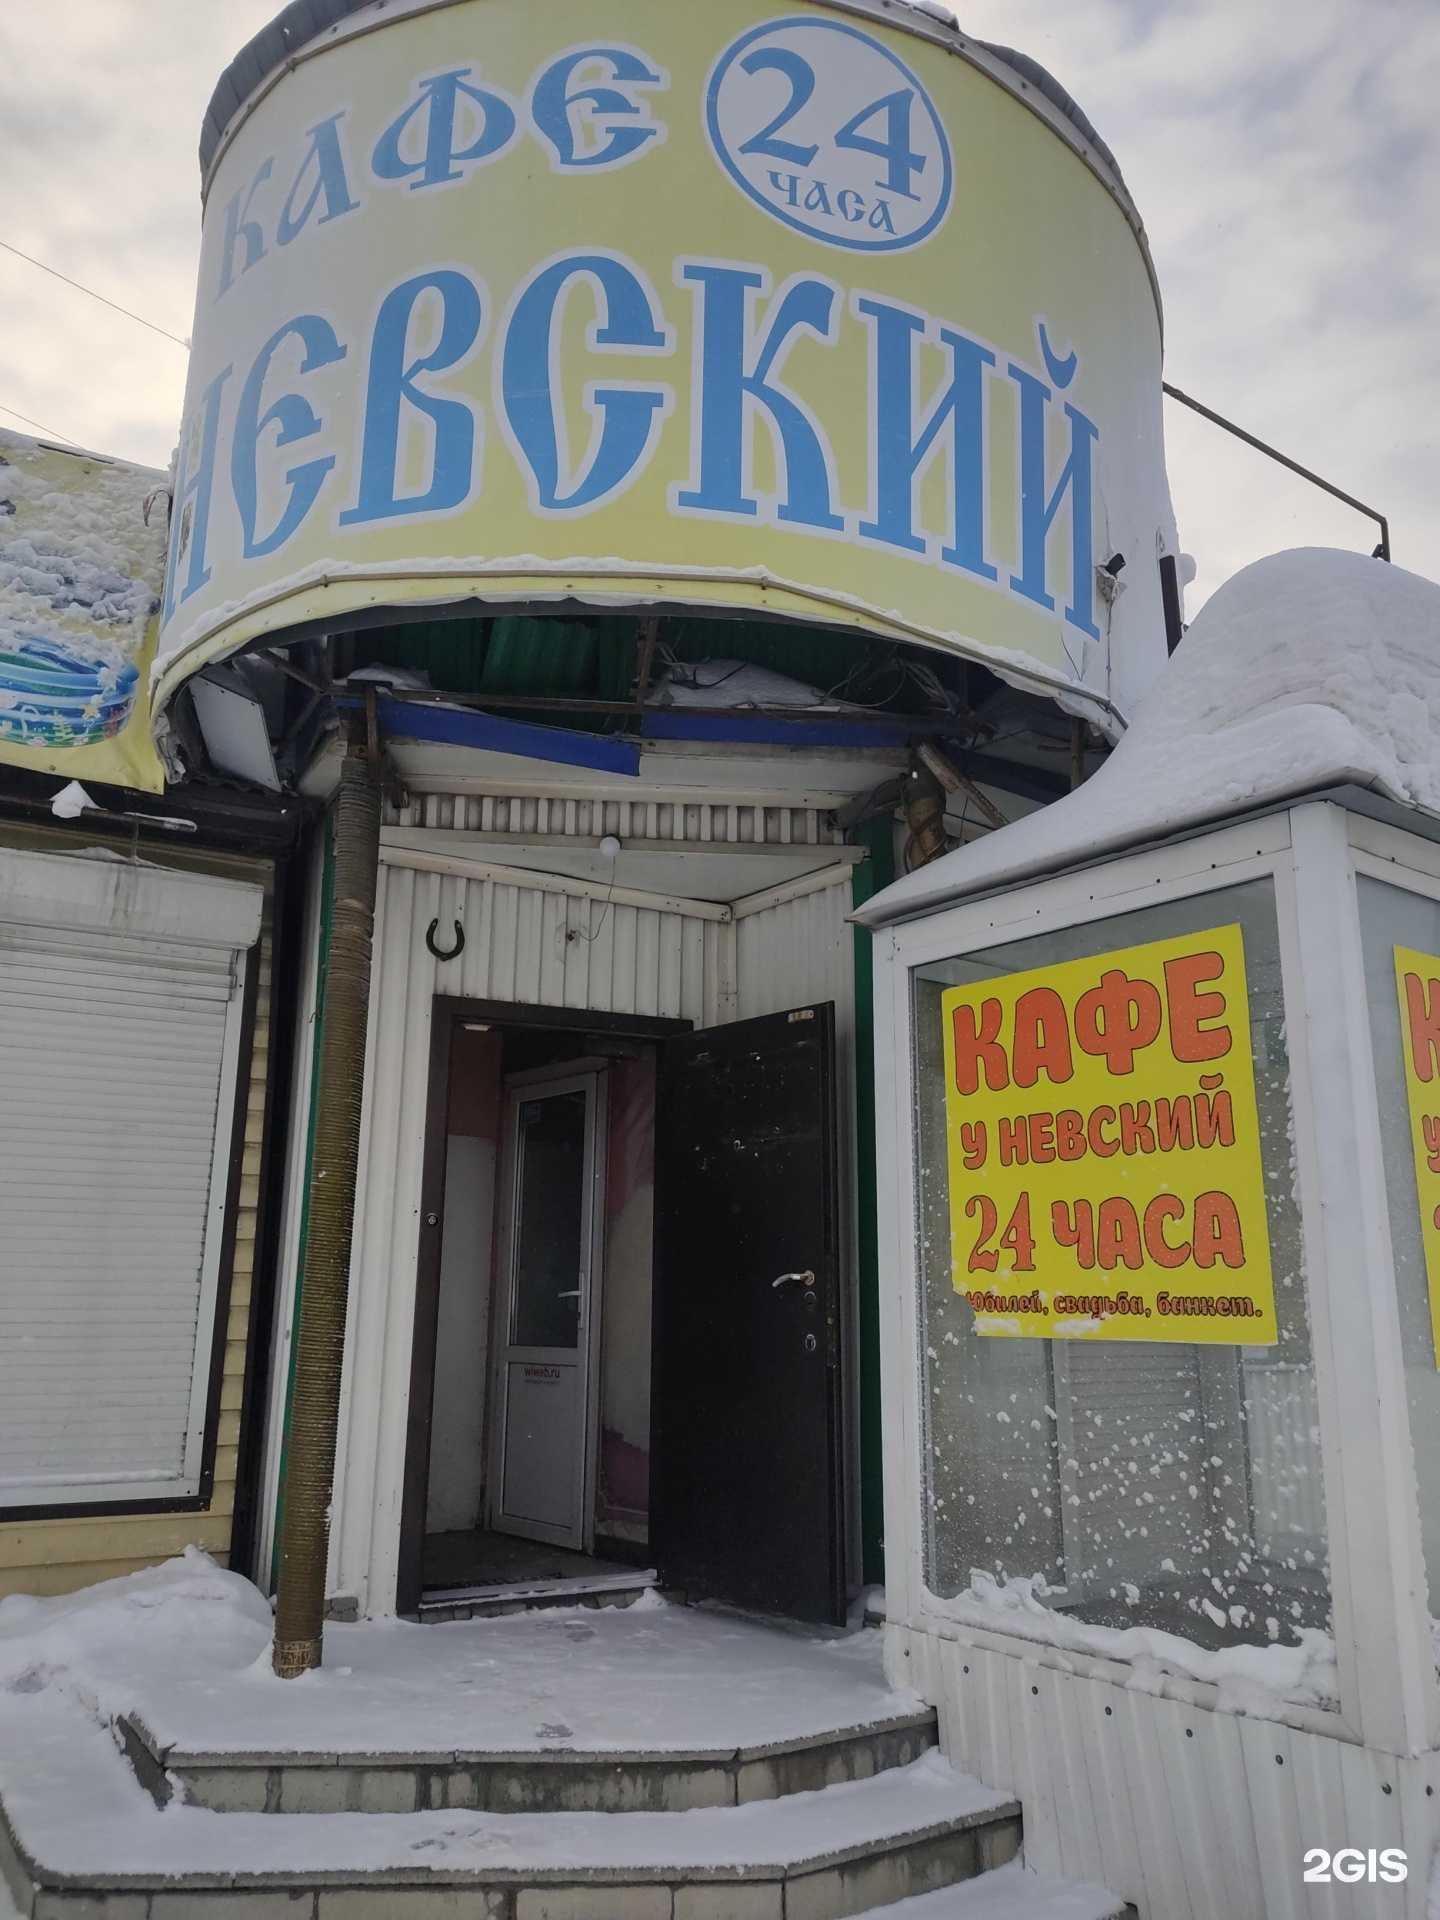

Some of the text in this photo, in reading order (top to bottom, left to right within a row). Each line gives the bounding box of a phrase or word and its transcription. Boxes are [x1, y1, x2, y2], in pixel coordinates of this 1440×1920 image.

[214, 48, 660, 304] КАФЕ
[738, 46, 928, 202] 24
[766, 169, 898, 236] ЧАСА
[160, 255, 1099, 642] НЕВСКИЙ
[952, 950, 1233, 1096] КАФЕ
[998, 1072, 1236, 1167] НЕВСКИЙ
[965, 1190, 1247, 1273] 24 ЧАСА
[1053, 1291, 1152, 1320] свадьба,
[1156, 1291, 1264, 1317] банкет.
